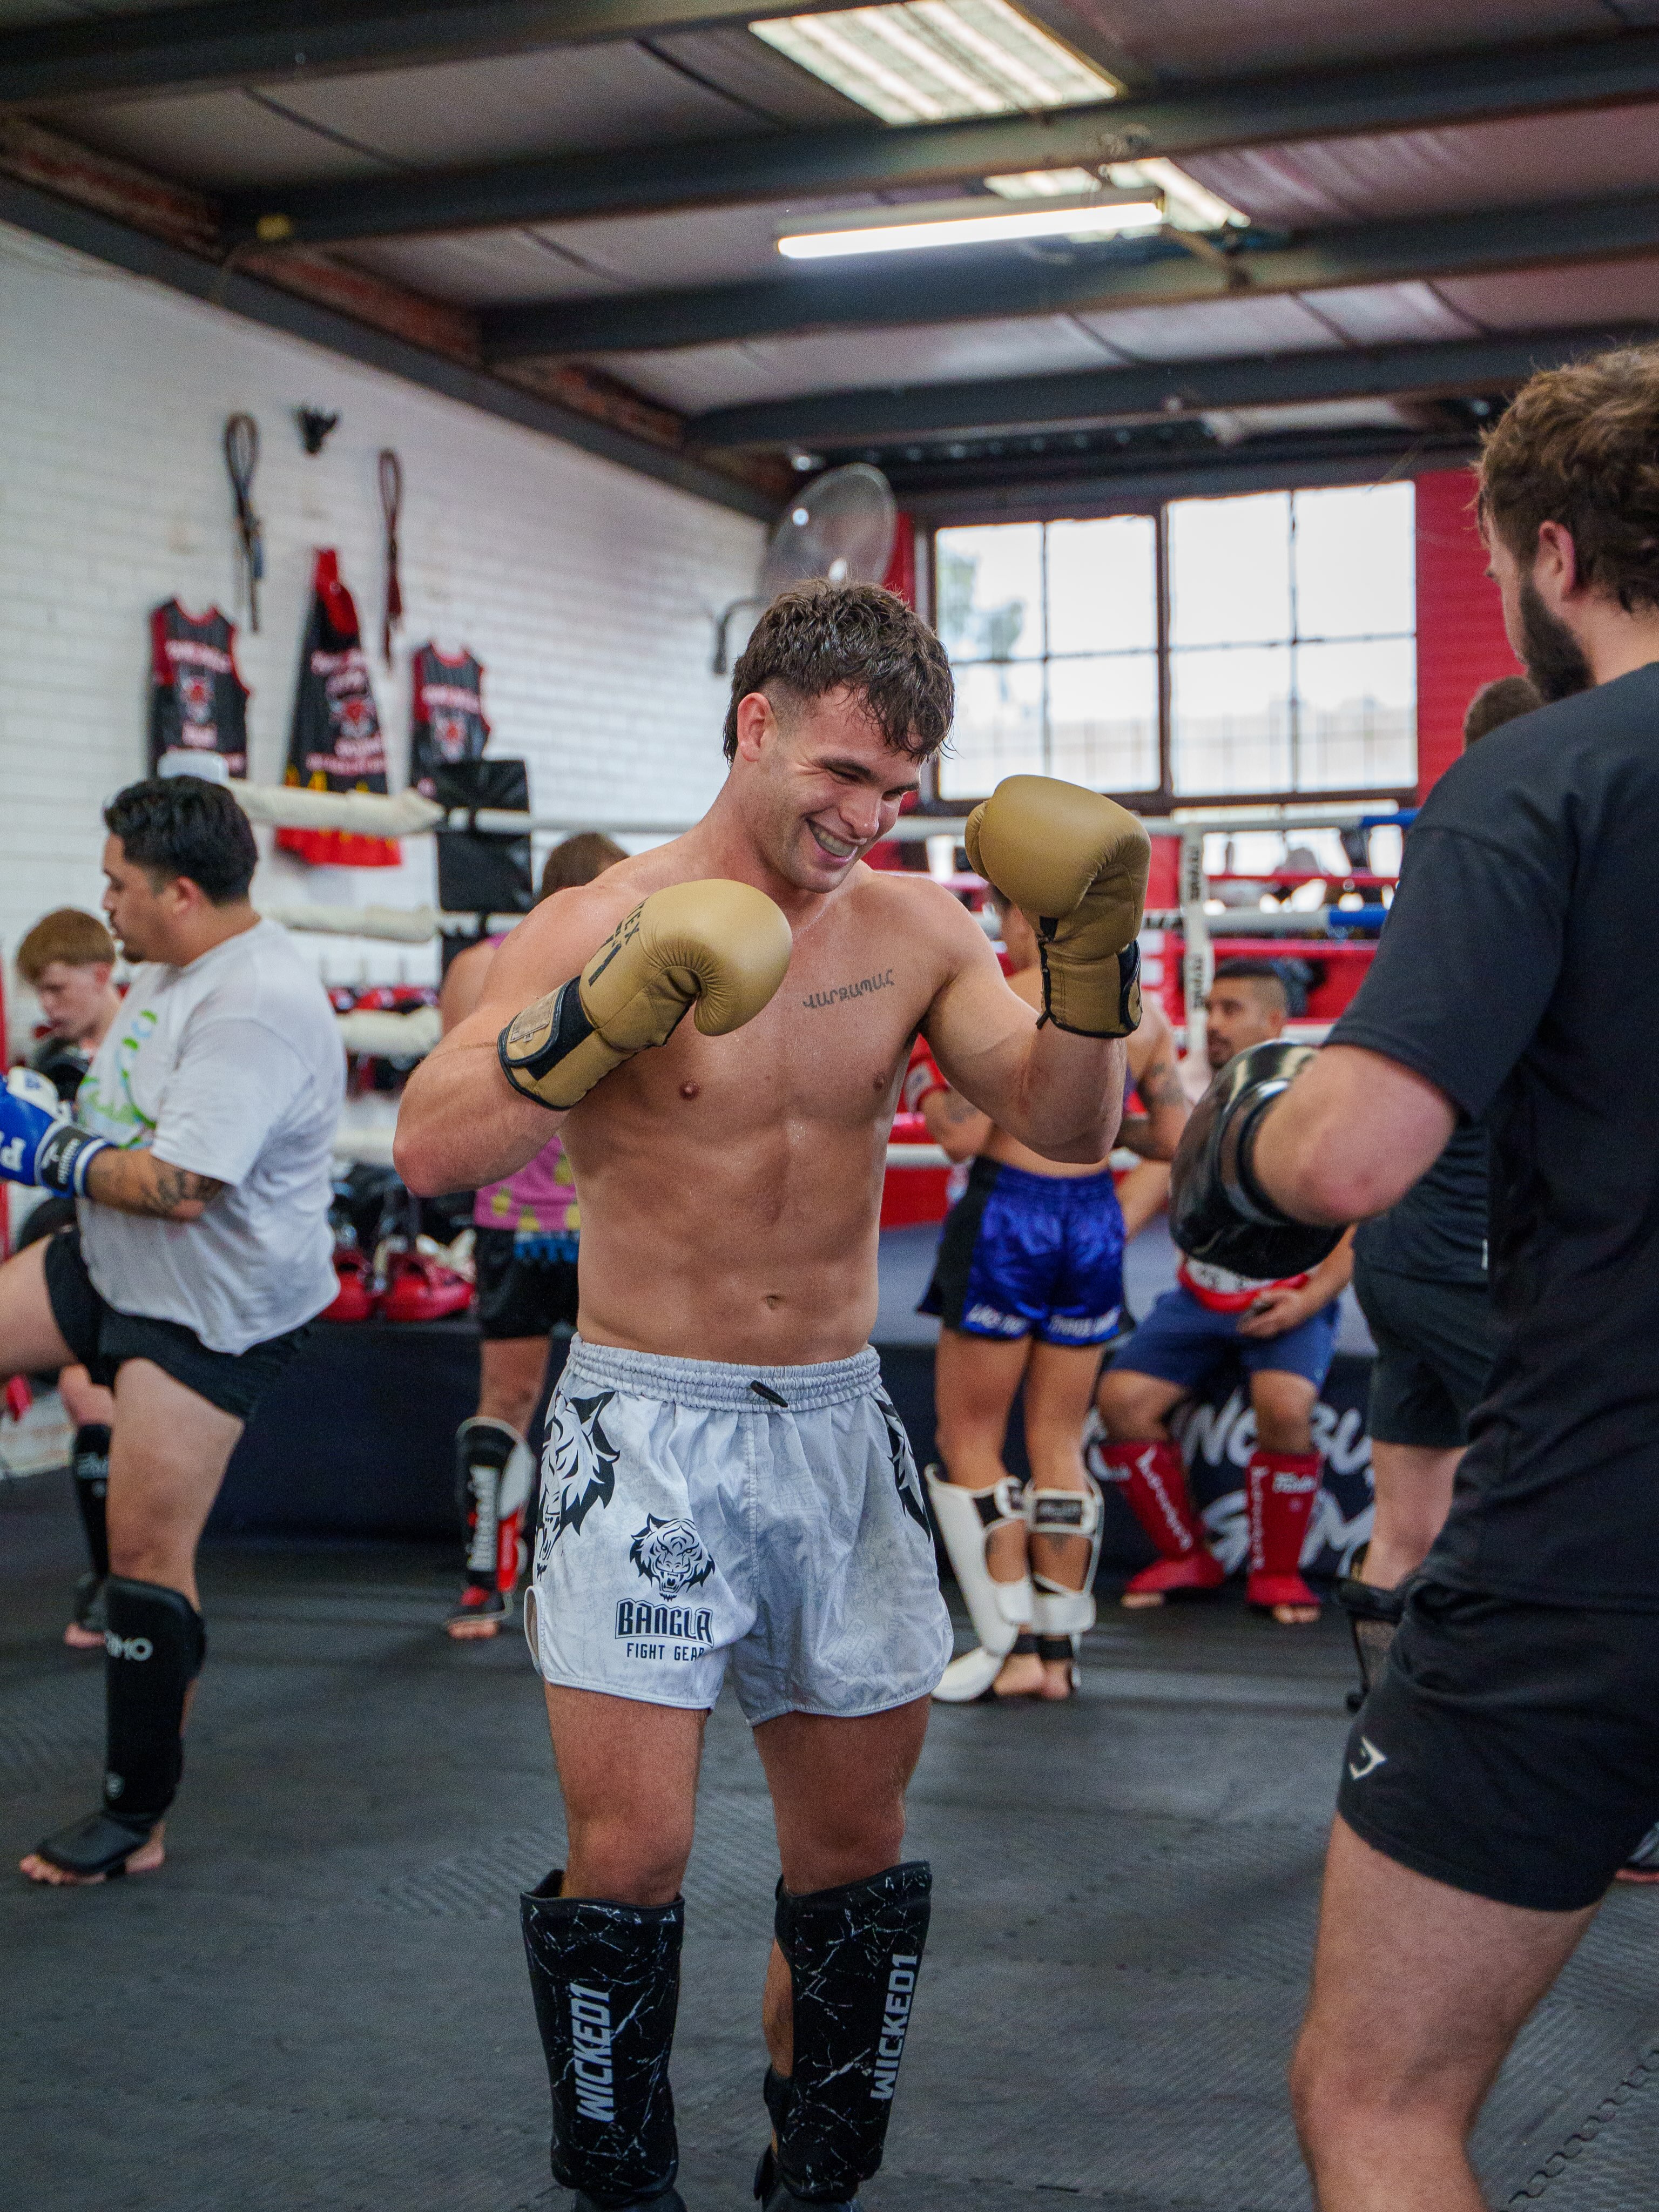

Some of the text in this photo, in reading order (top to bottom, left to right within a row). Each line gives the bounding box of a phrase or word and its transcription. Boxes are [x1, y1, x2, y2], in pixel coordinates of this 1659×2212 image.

[617, 1600, 713, 1644] BANGLA
[626, 1642, 665, 1660] FIGHT
[569, 1982, 615, 2123] WICKED1
[869, 1953, 918, 2100] WICKED1
